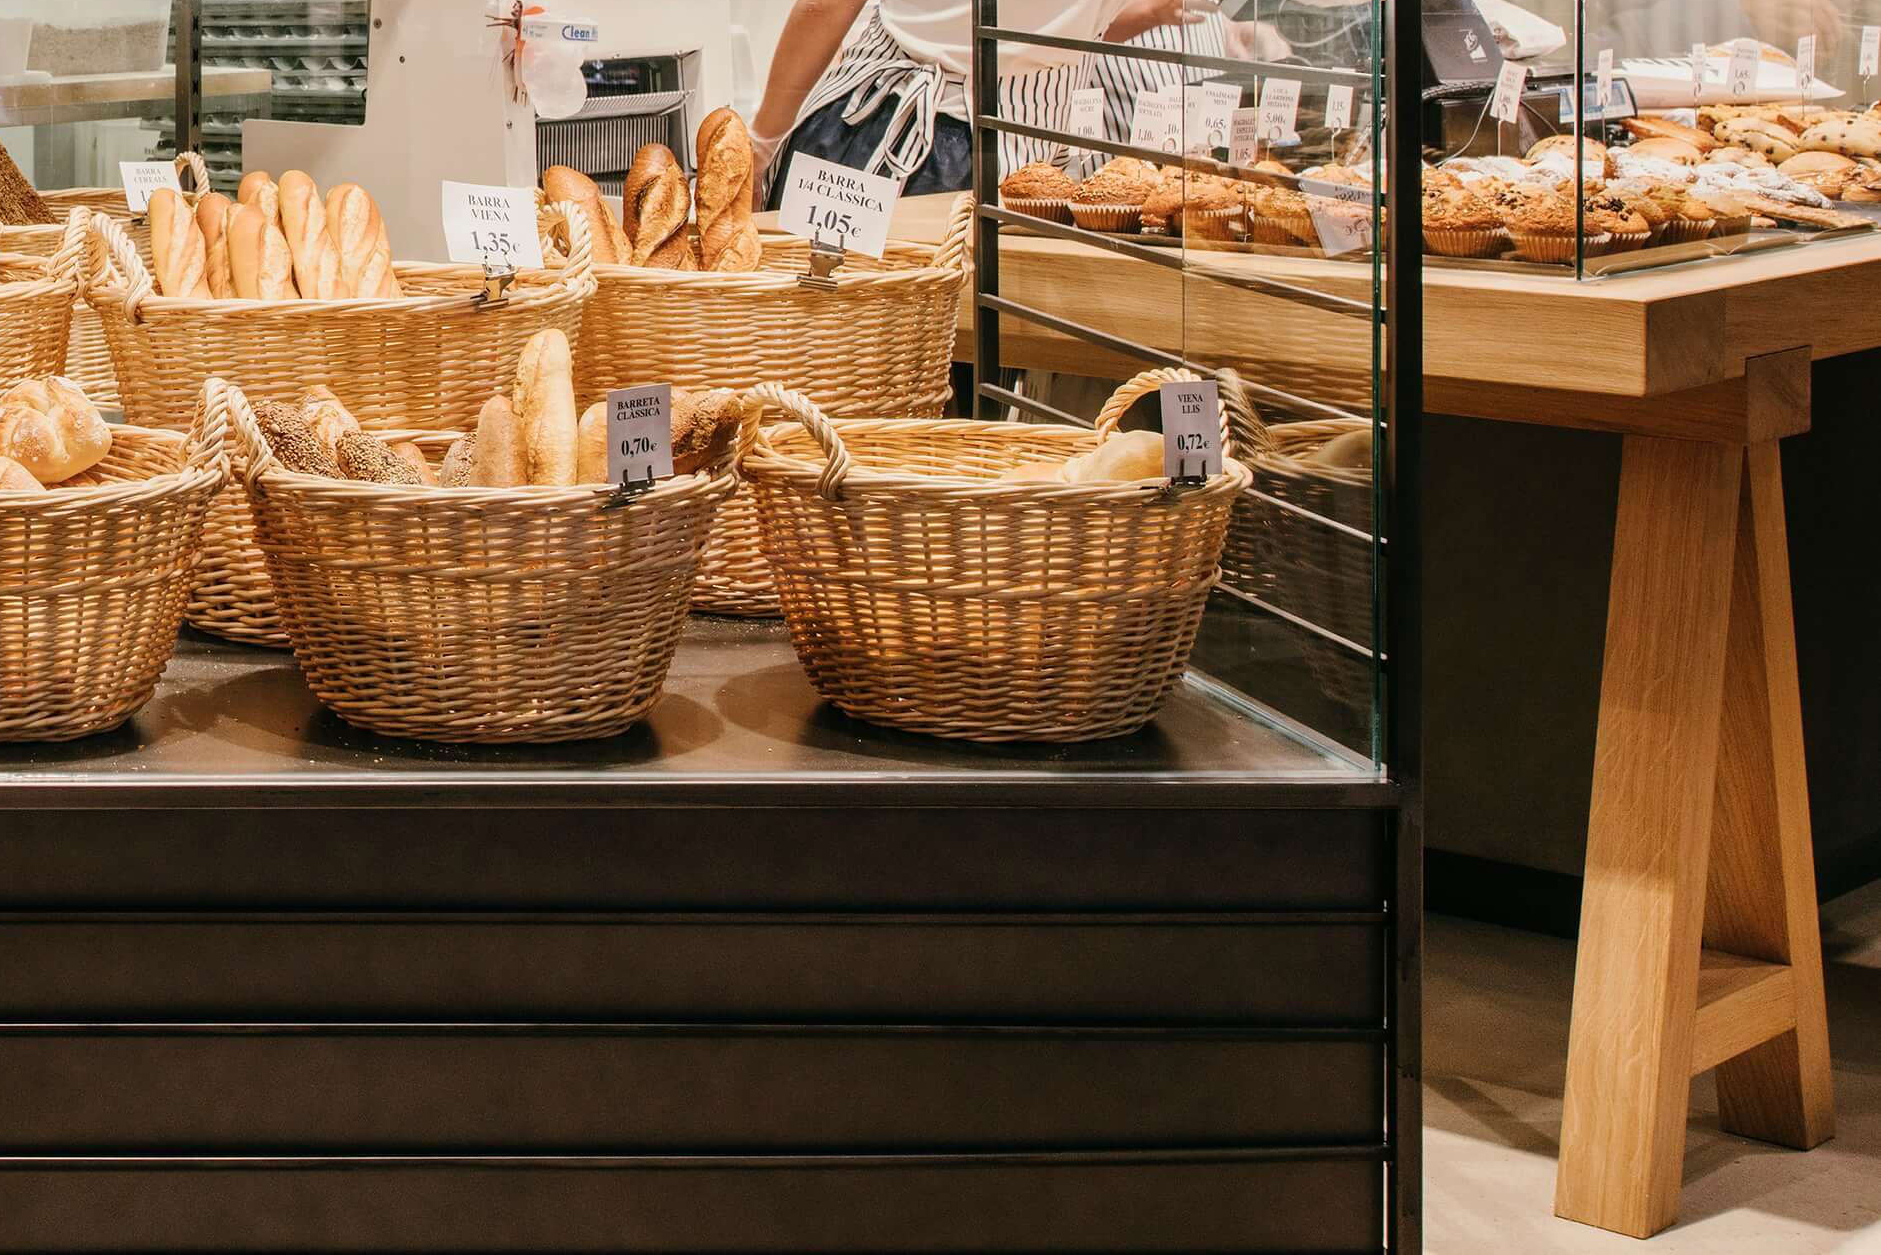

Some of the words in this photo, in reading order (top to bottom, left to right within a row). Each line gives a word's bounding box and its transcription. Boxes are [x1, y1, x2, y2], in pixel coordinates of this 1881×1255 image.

[562, 25, 591, 41] Clean
[798, 178, 814, 192] 1/4
[818, 169, 866, 193] BARRA
[468, 193, 511, 209] BARRA
[471, 208, 510, 222] VIENA
[806, 204, 862, 238] 1,05€
[617, 396, 661, 411] BARRETA
[1177, 393, 1204, 403] VIENA
[1181, 404, 1201, 414] LLIS
[620, 436, 659, 458] 0,70€
[1177, 433, 1211, 454] 0,72€
